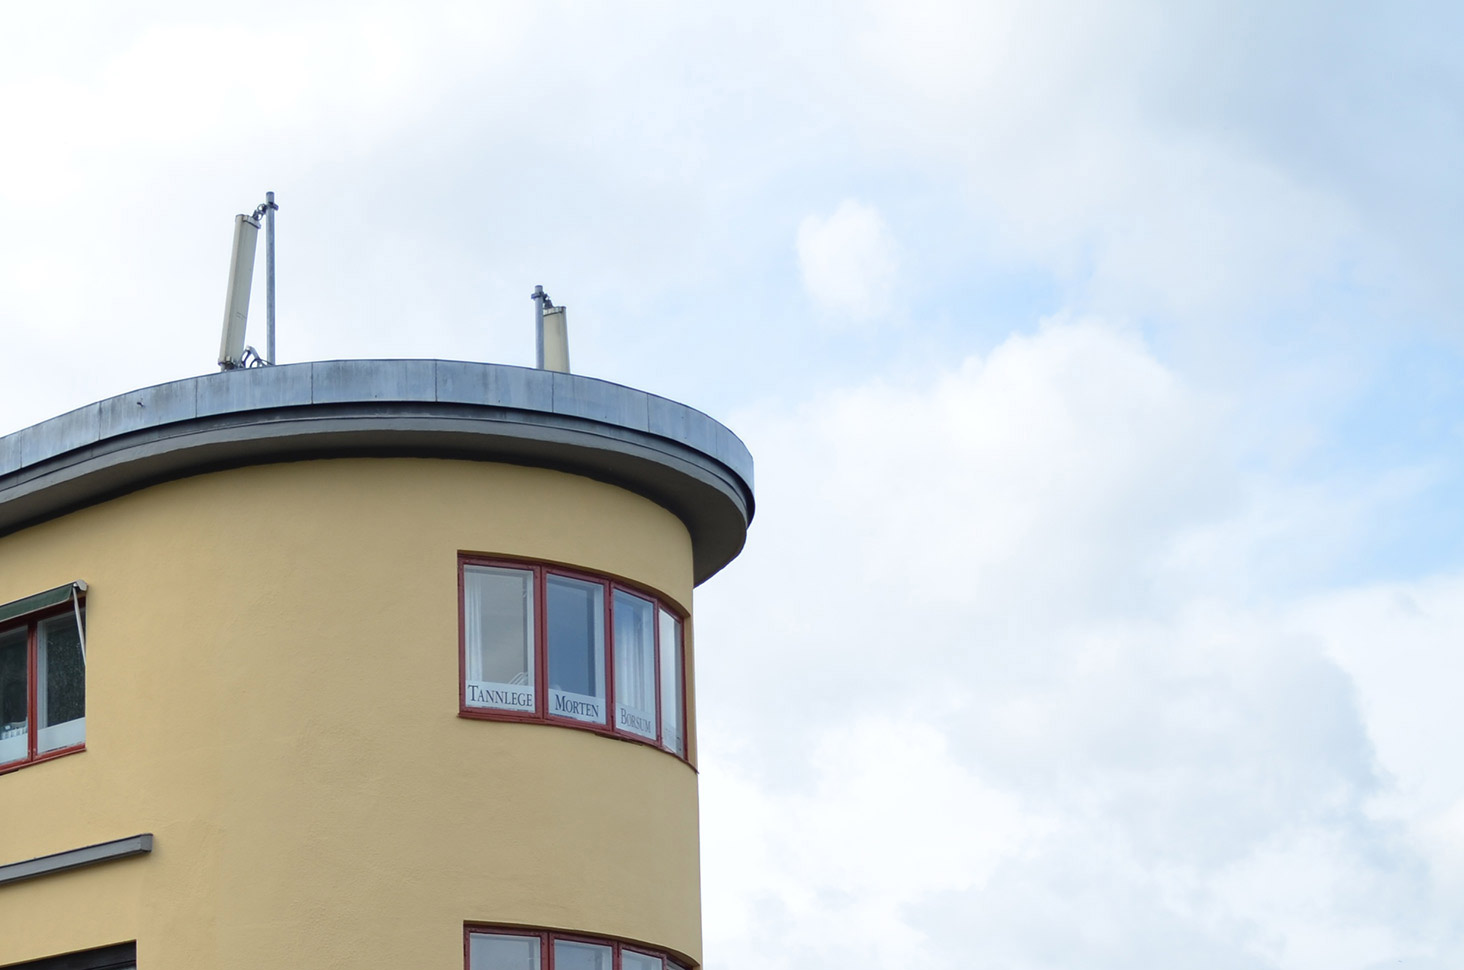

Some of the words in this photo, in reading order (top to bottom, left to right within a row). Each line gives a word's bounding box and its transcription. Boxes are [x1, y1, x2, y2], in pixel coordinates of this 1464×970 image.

[468, 684, 533, 707] TANNLEGE
[554, 694, 599, 718] MORTEN
[620, 708, 651, 734] BORSUM
